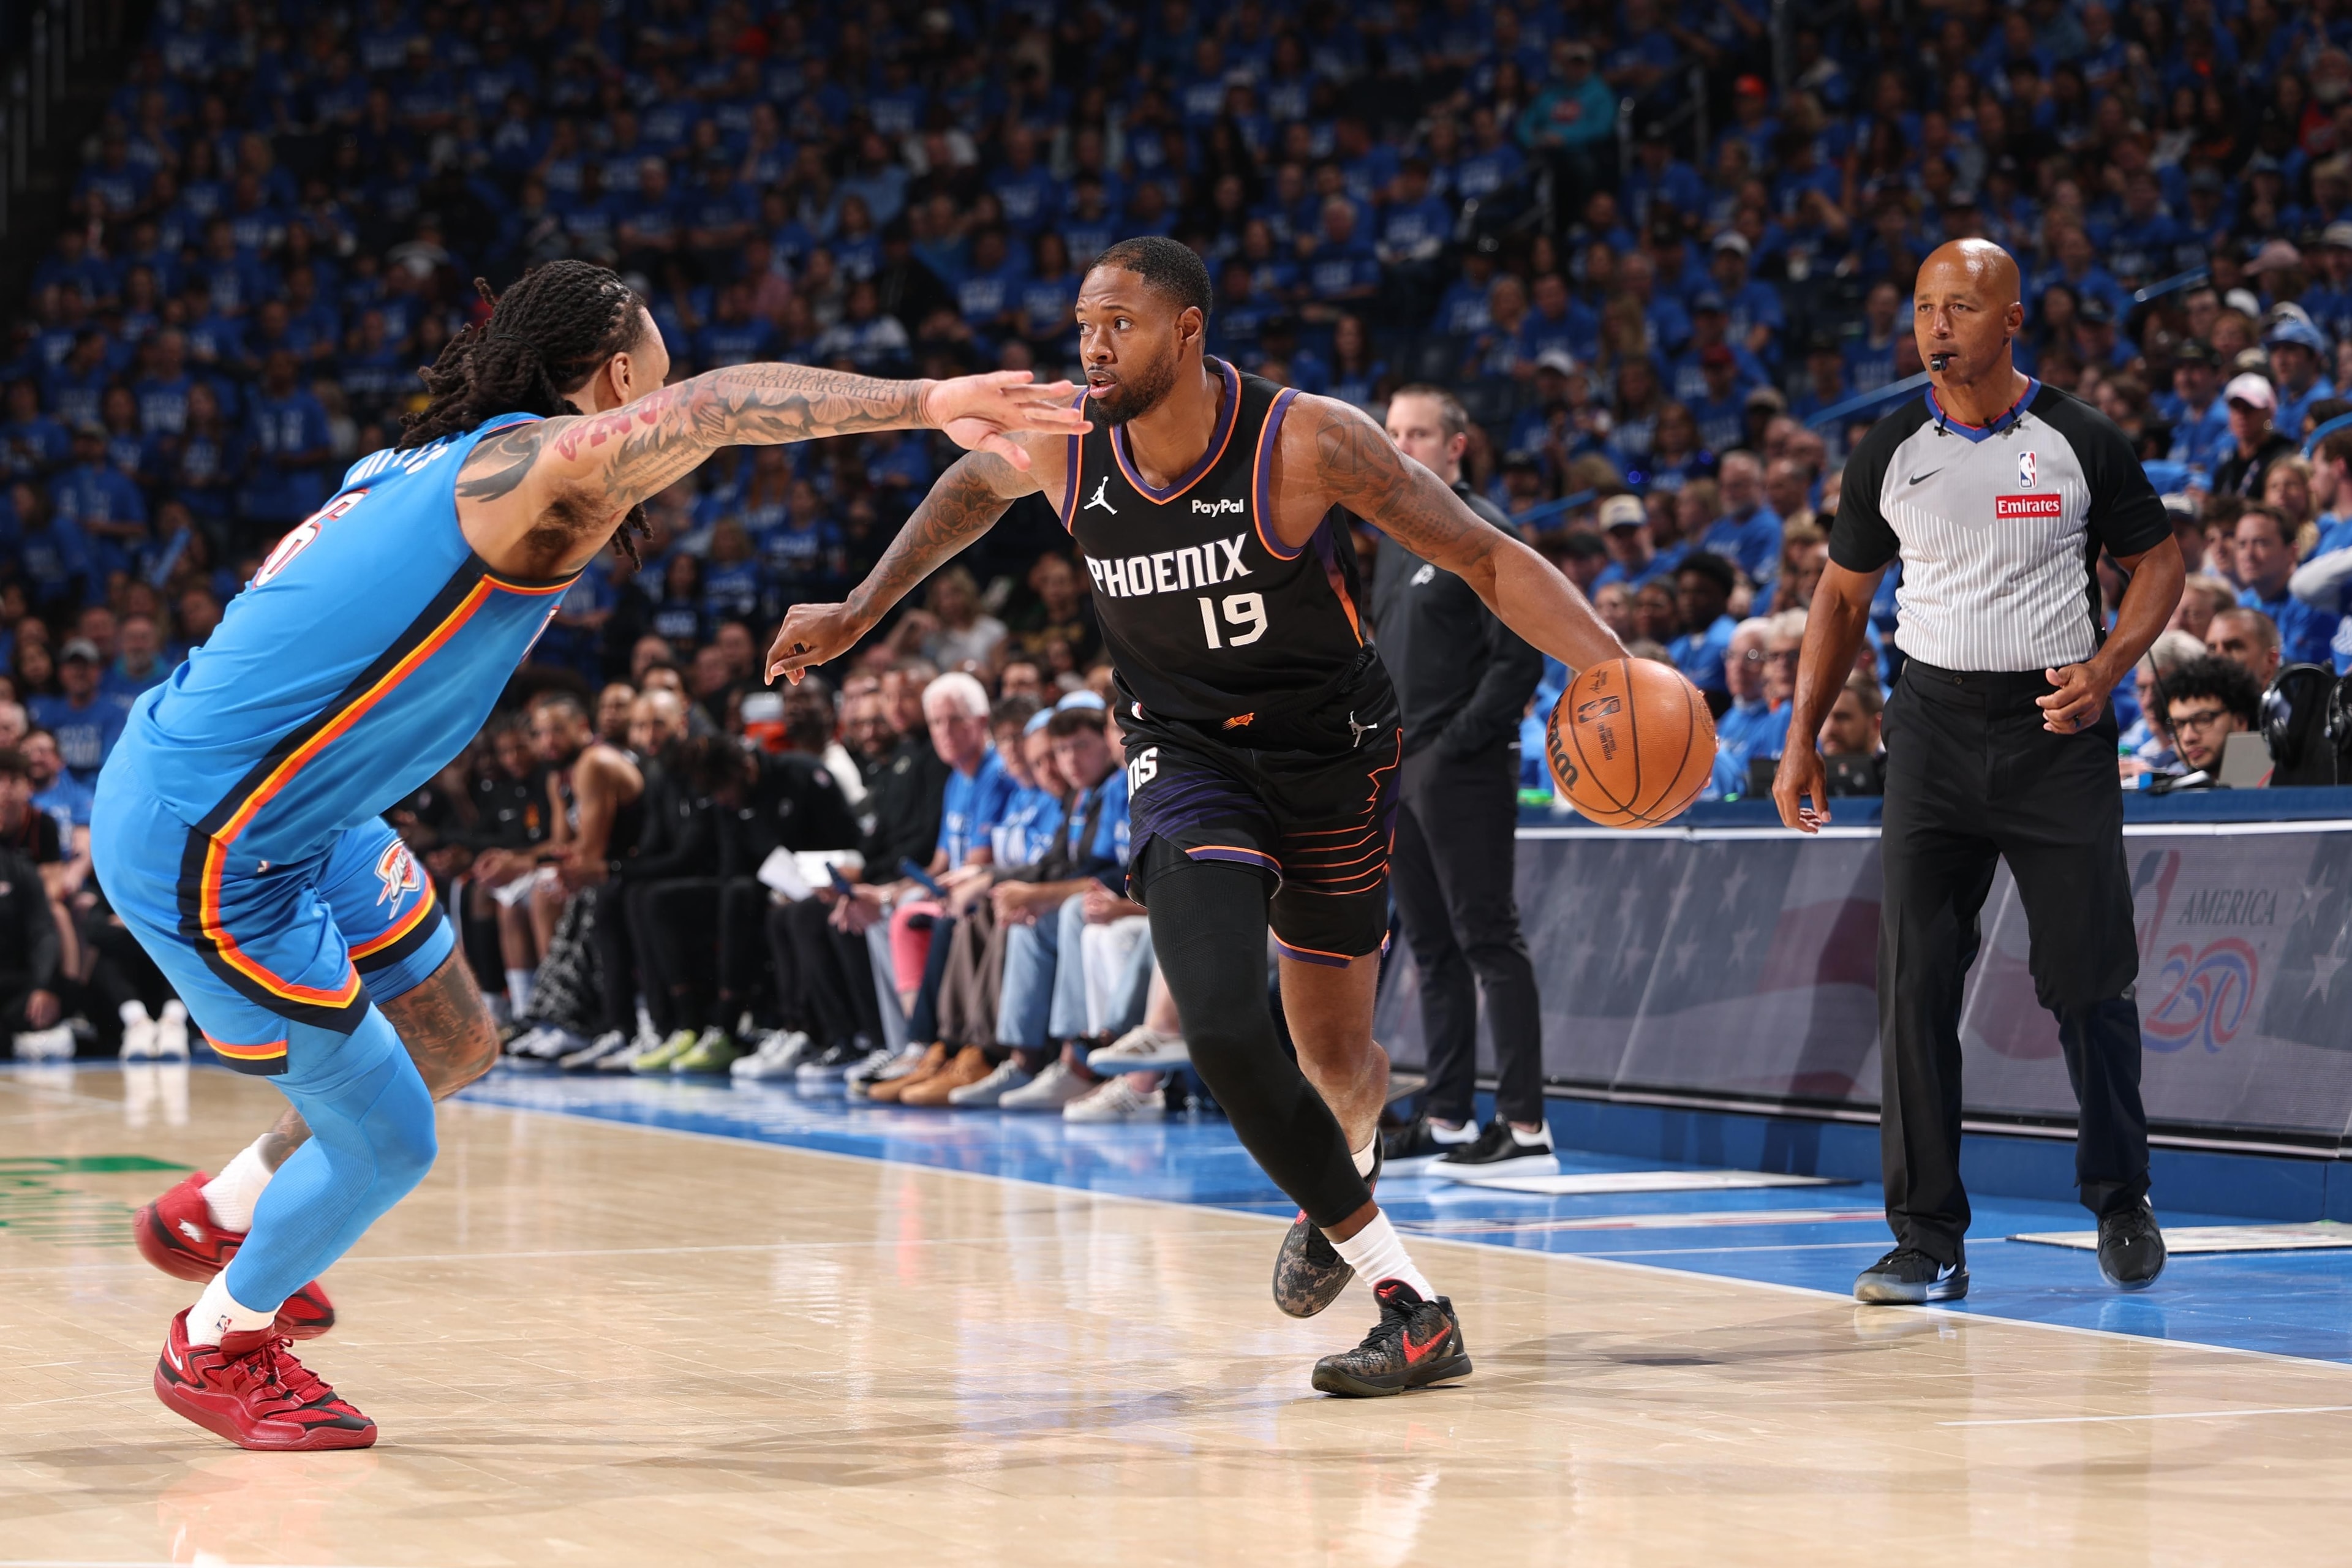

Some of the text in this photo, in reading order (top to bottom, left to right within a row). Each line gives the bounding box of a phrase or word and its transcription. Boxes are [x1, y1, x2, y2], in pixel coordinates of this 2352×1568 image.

[1192, 499, 1244, 518] PayPal
[1997, 498, 2060, 514] Emirates
[1084, 532, 1253, 598] PHOENIX
[1197, 592, 1268, 649] 19
[2178, 889, 2278, 926] AMERICA
[2141, 937, 2259, 1054] 250
